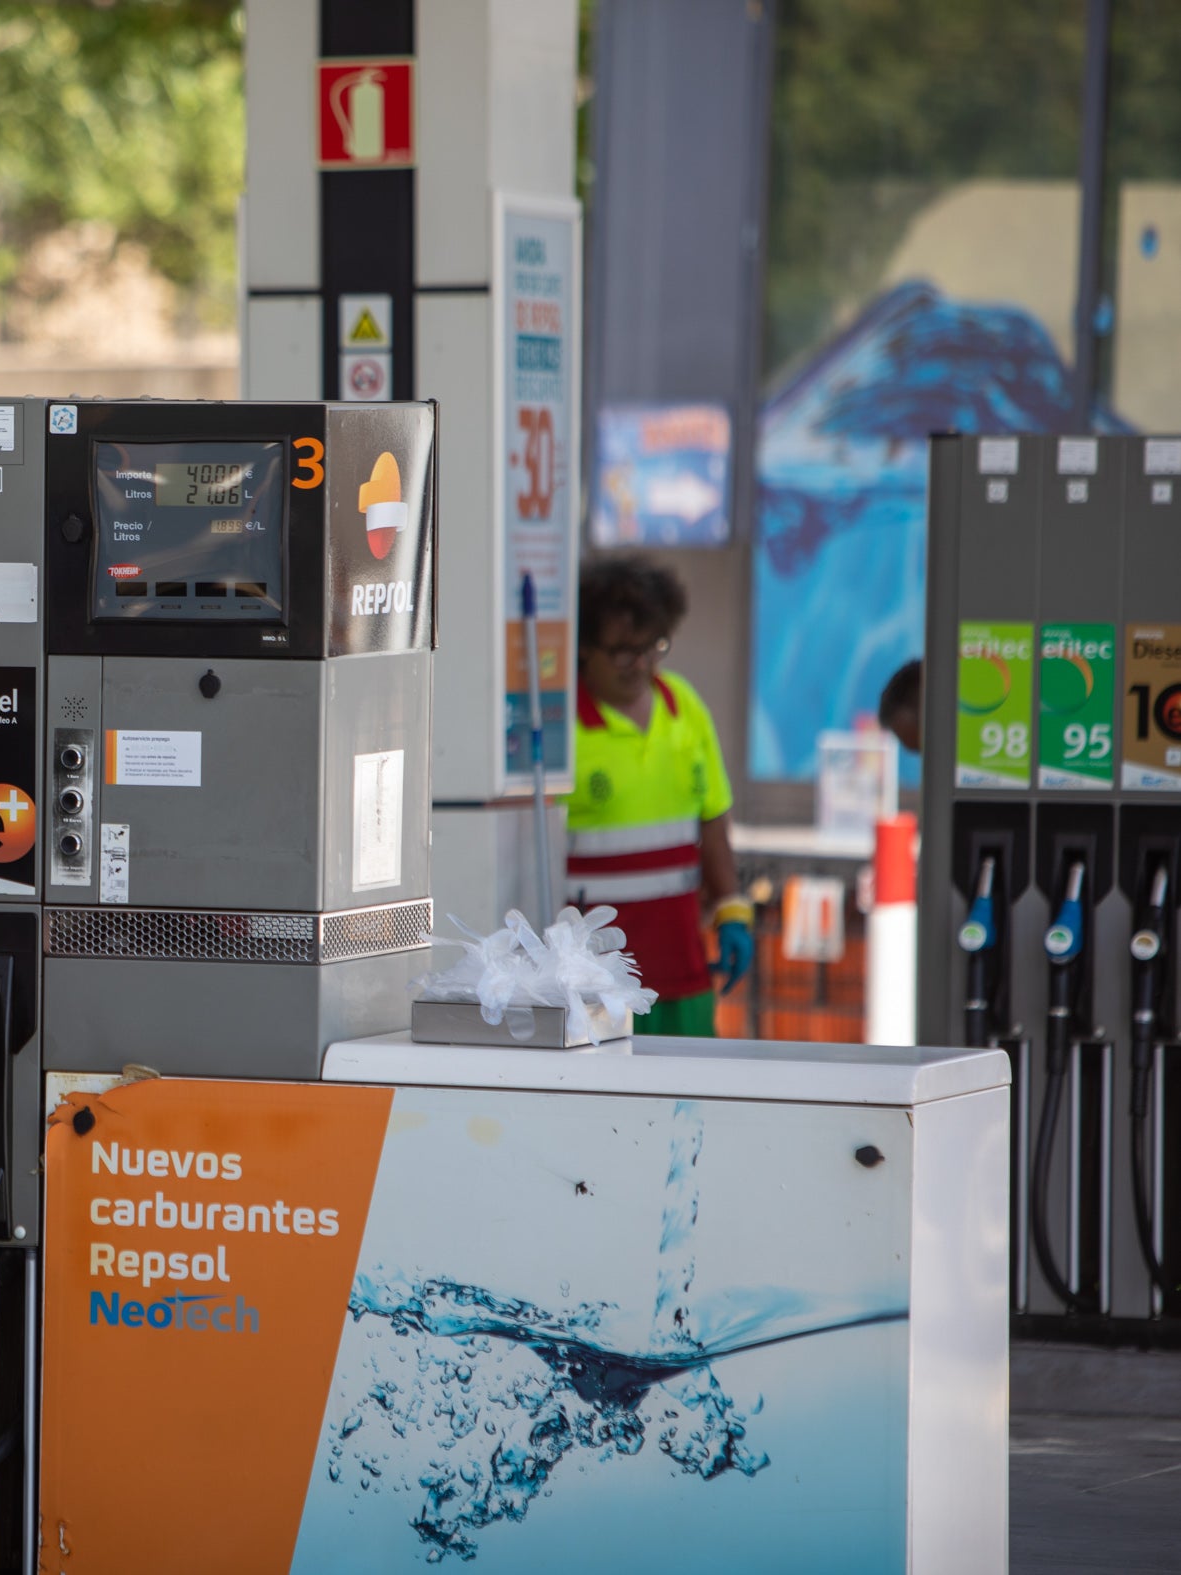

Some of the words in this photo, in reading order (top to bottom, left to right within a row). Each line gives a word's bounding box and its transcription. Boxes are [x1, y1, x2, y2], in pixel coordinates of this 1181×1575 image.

[115, 470, 153, 481] Importe
[244, 470, 254, 480] €
[291, 437, 325, 490] 3
[125, 490, 153, 499] Litros
[113, 521, 144, 531] Precio
[146, 520, 153, 531] /
[244, 521, 267, 531] €/L
[113, 532, 141, 542] Litros
[108, 566, 140, 577] TOKHEIM
[351, 580, 414, 617] REPSOL
[1042, 639, 1112, 661] efitec
[11, 717, 18, 725] A
[981, 722, 1029, 759] 98
[1063, 723, 1112, 760] 95
[92, 1140, 243, 1181] Nuevos
[90, 1191, 340, 1237] carburantes
[90, 1242, 231, 1288] Repsol
